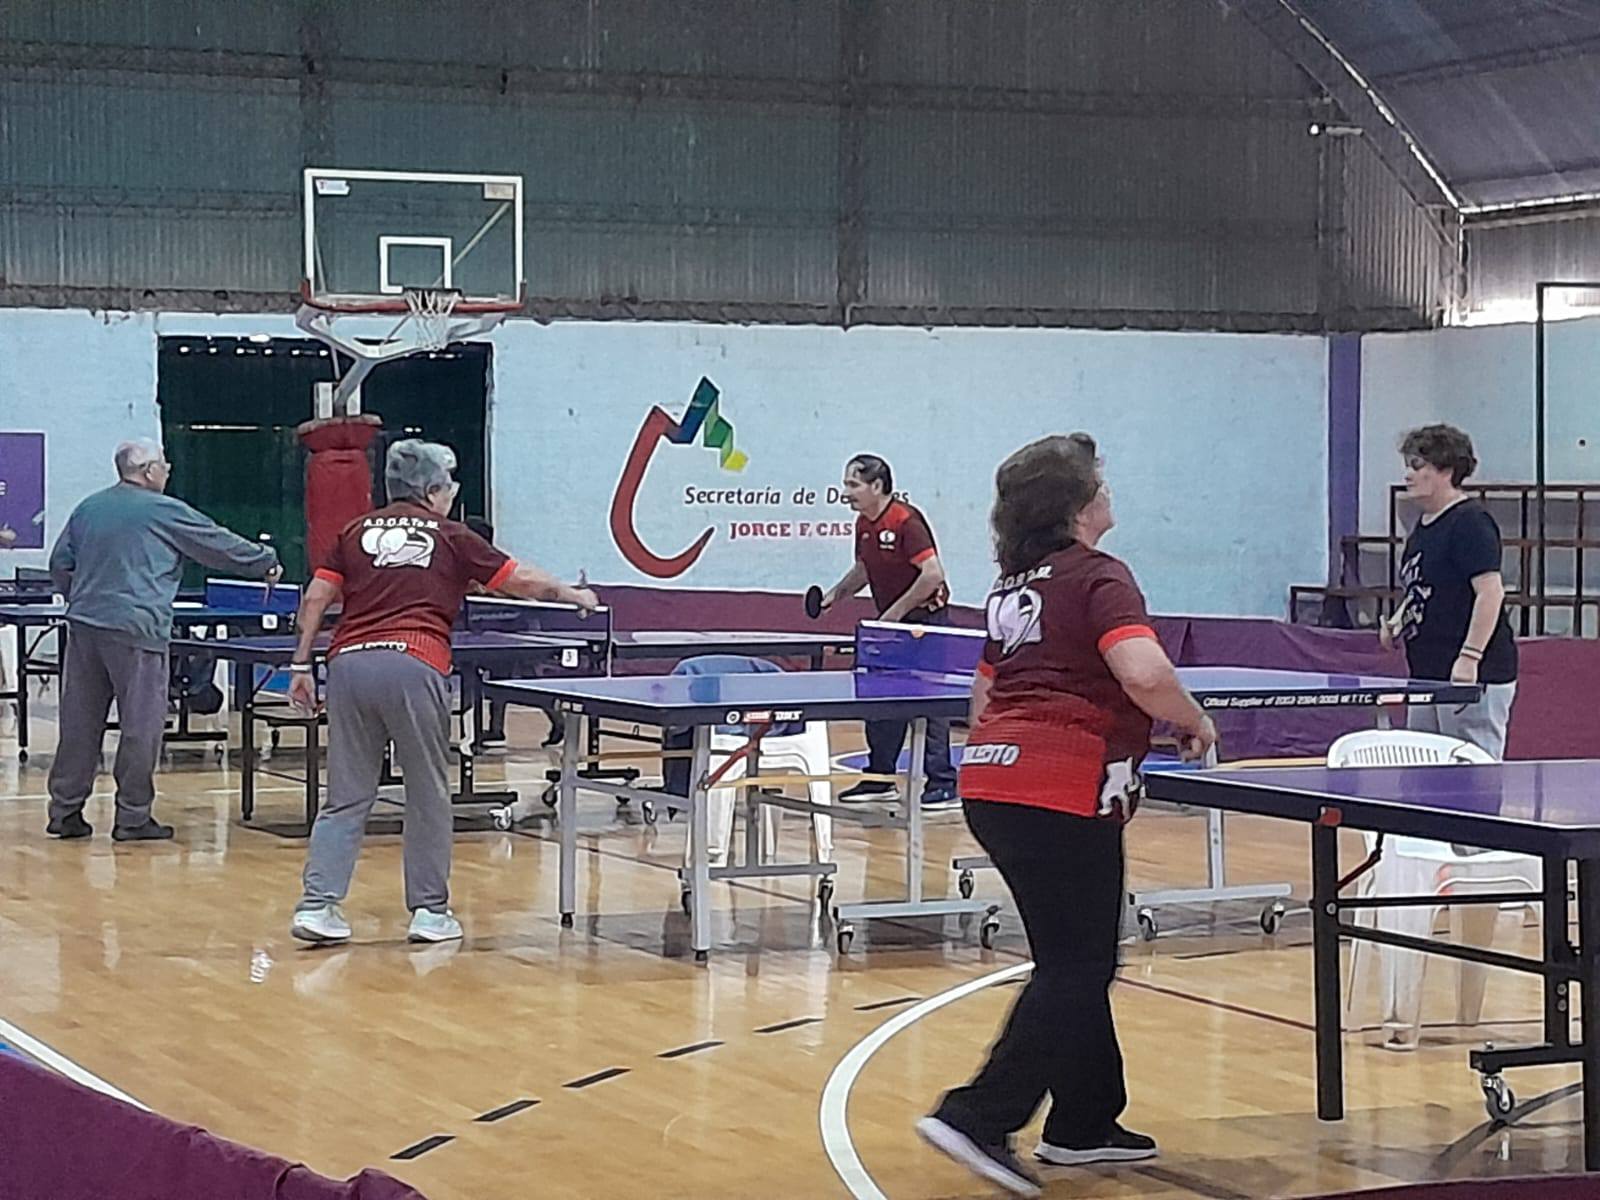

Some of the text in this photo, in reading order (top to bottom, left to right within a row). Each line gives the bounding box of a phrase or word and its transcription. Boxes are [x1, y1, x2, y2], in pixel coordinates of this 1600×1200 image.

[685, 486, 781, 505] Secretaría
[793, 487, 816, 505] de
[730, 522, 791, 540] JORGE
